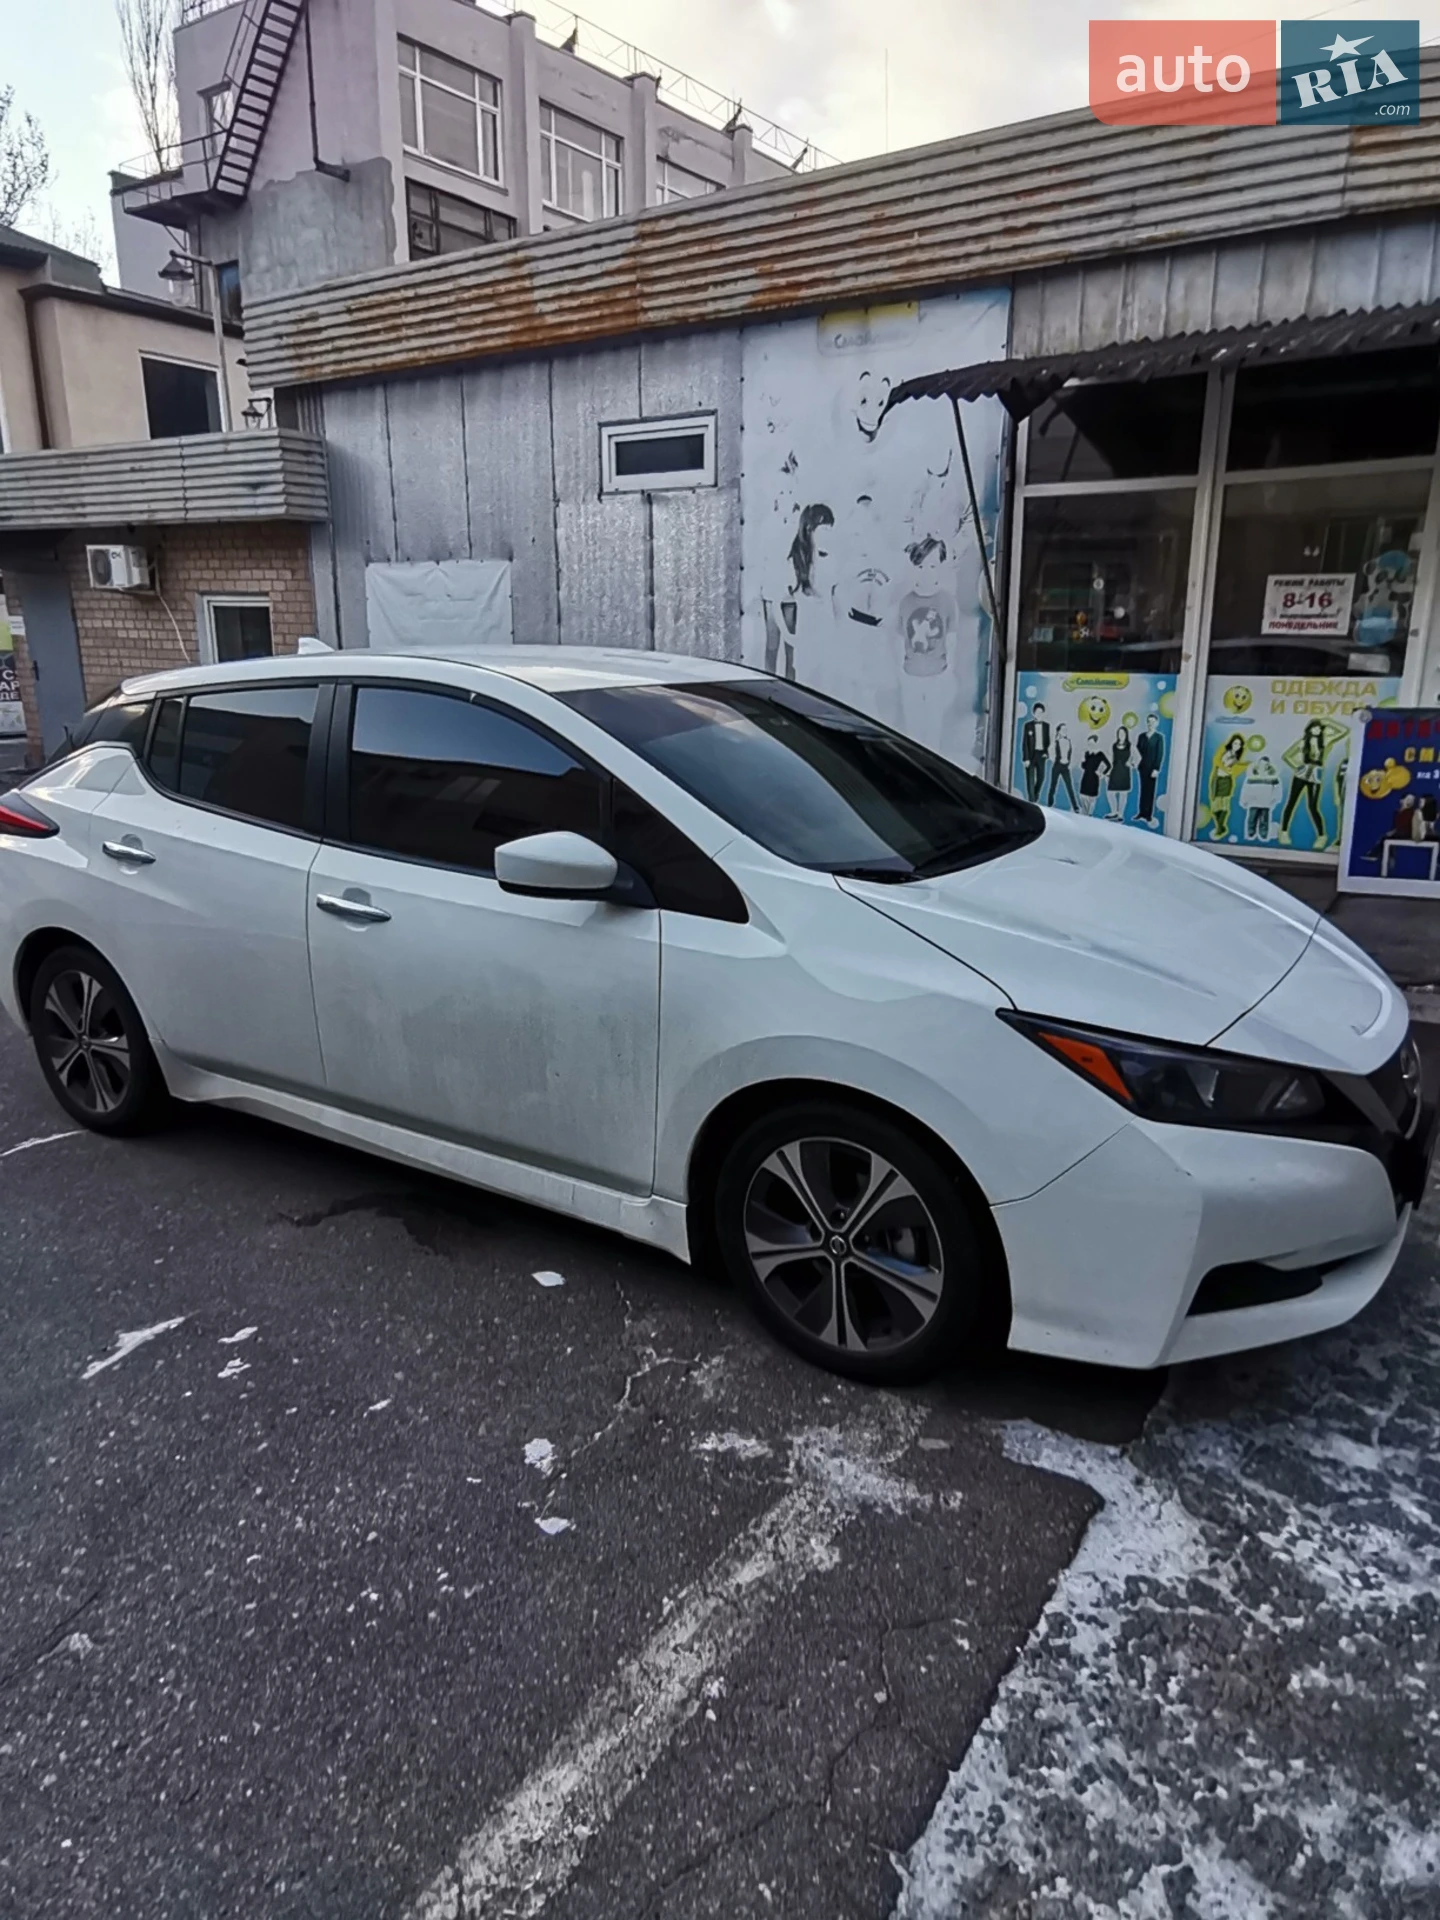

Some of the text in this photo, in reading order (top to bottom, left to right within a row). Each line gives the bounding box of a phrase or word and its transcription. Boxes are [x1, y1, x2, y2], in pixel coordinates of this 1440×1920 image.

[1282, 591, 1333, 609] 8-16
[1271, 679, 1377, 698] ОДЕЖДА
[1270, 700, 1364, 716] И ОБУВ
